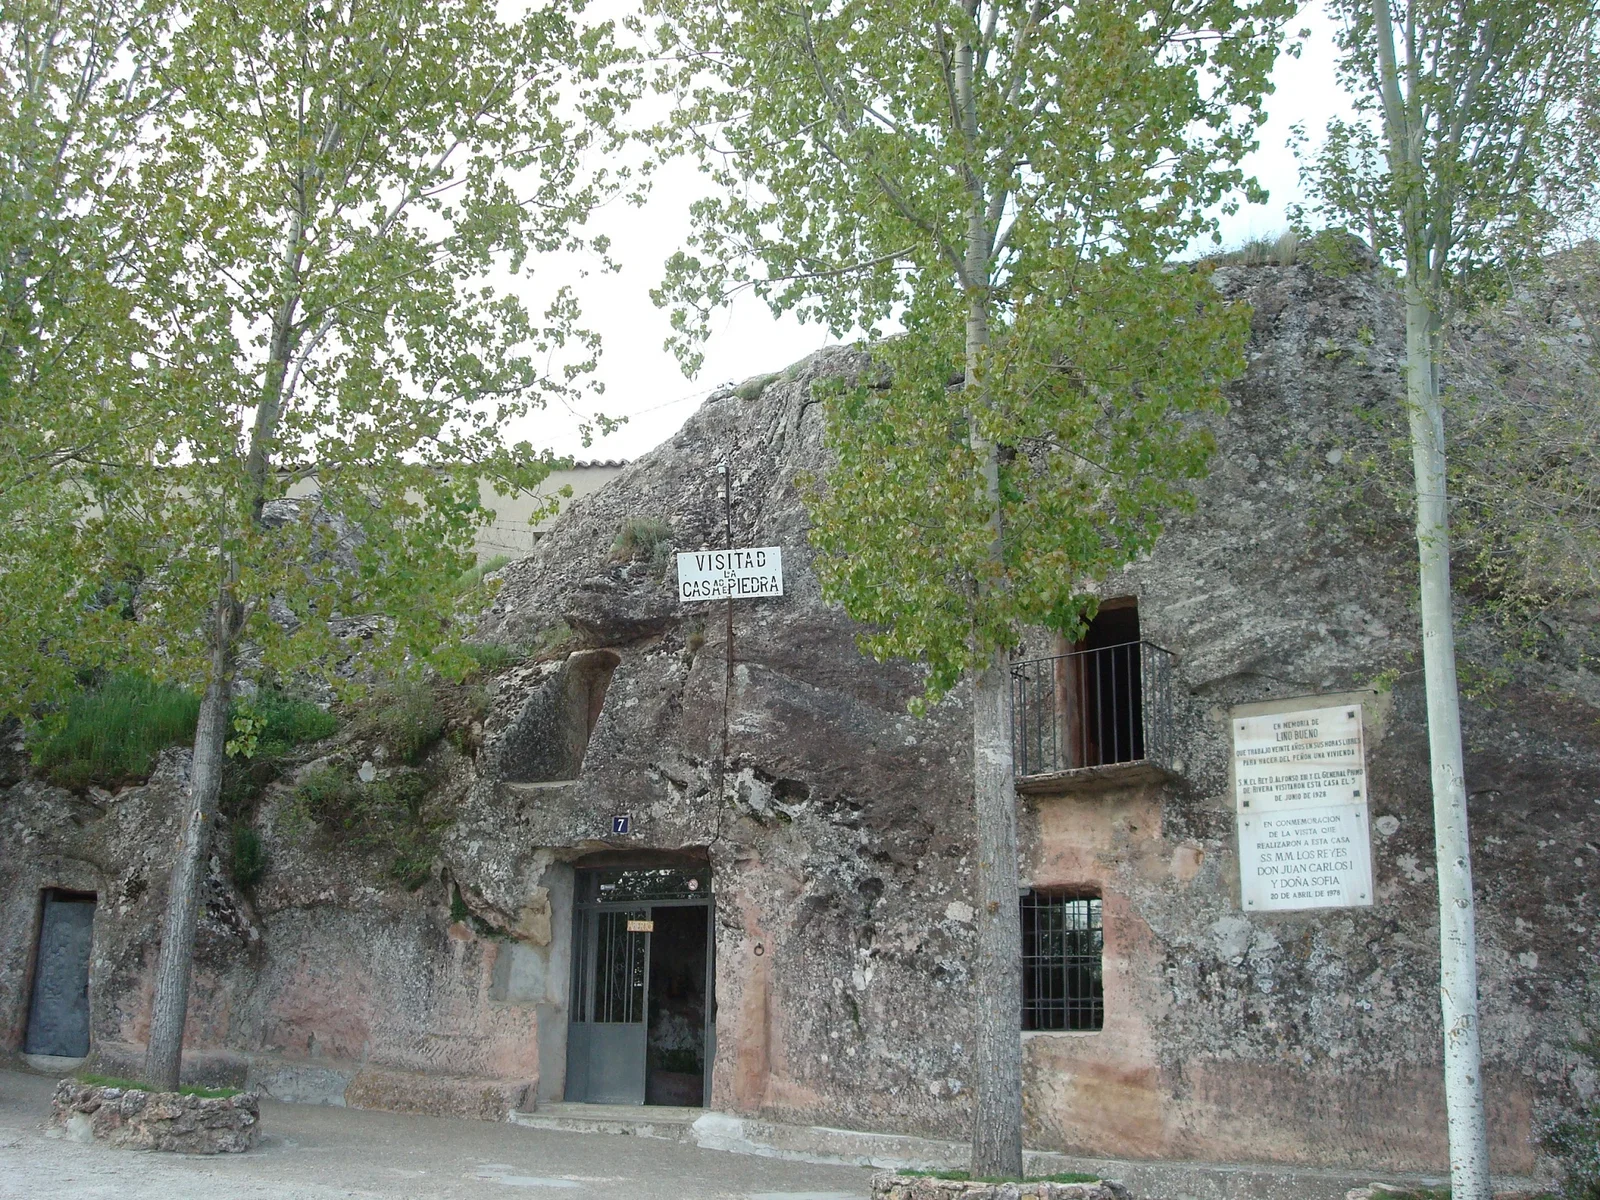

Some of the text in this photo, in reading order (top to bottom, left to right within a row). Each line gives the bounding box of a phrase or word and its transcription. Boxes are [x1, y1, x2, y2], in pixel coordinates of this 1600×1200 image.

[696, 551, 765, 571] VISITAD
[724, 570, 736, 578] LA
[683, 580, 720, 597] CASA
[728, 576, 779, 594] PIEDRA
[1276, 729, 1318, 741] LINO BUENO
[1327, 749, 1354, 758] VIVIENDA
[1322, 770, 1345, 778] GENERAL
[1253, 785, 1273, 793] RIVERA
[1275, 783, 1305, 791] VISITARON
[1285, 793, 1301, 801] JUNIO
[617, 818, 624, 832] 7
[1276, 816, 1340, 827] CONMEMORACION
[1257, 840, 1301, 849] REALIZARON
[1297, 850, 1315, 859] LOS
[1317, 848, 1347, 859] REYES
[1258, 861, 1352, 876] DON JUAN CARLOS I
[1271, 876, 1340, 888] Y DOÑA SOFIA
